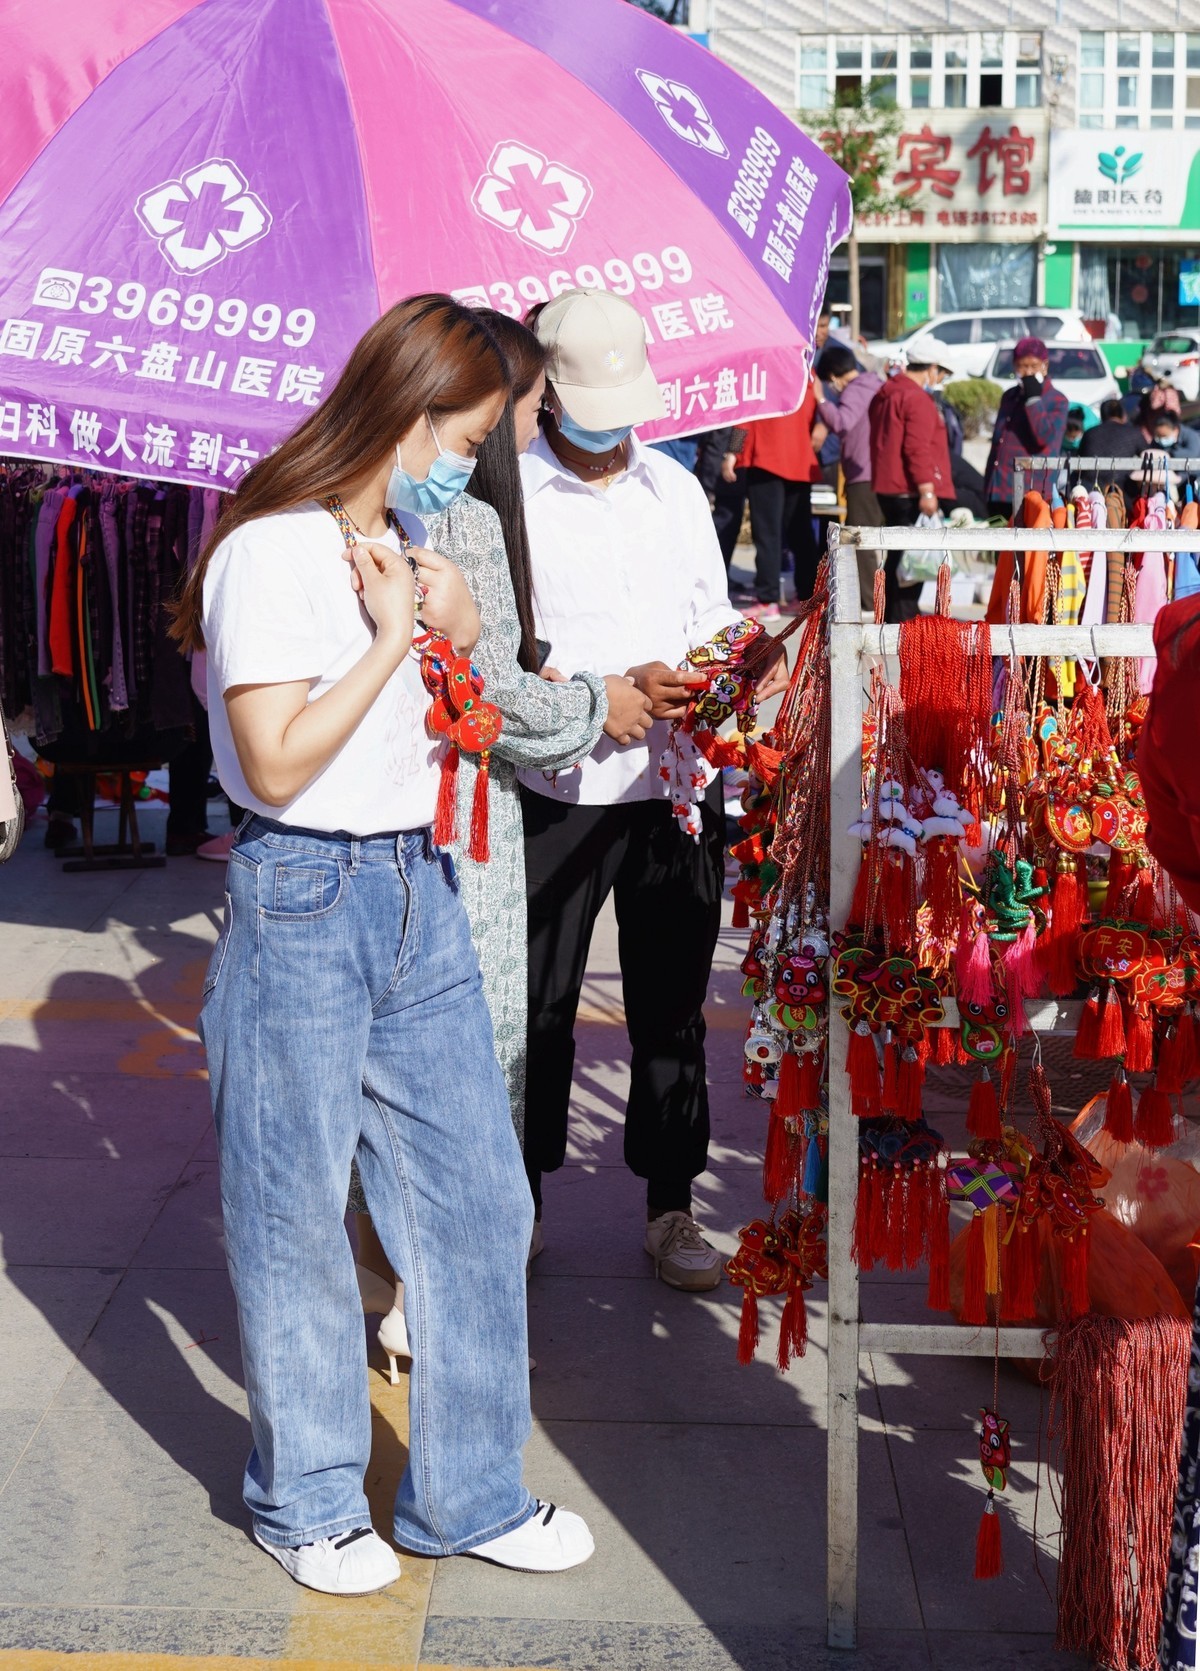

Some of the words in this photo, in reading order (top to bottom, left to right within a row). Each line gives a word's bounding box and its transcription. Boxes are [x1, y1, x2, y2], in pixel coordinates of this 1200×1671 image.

[733, 126, 782, 222] 3969999
[762, 156, 818, 284] 固原六盘山医院
[78, 276, 316, 348] 3969999
[644, 292, 734, 345] 医院
[0, 318, 325, 407] 固原六盘山医院
[69, 408, 178, 468] 做人流
[186, 430, 283, 479] 到六
[1097, 934, 1133, 957] 平安
[791, 1007, 804, 1020] 猪
[885, 1003, 899, 1019] 羊
[901, 1021, 917, 1036] 羊
